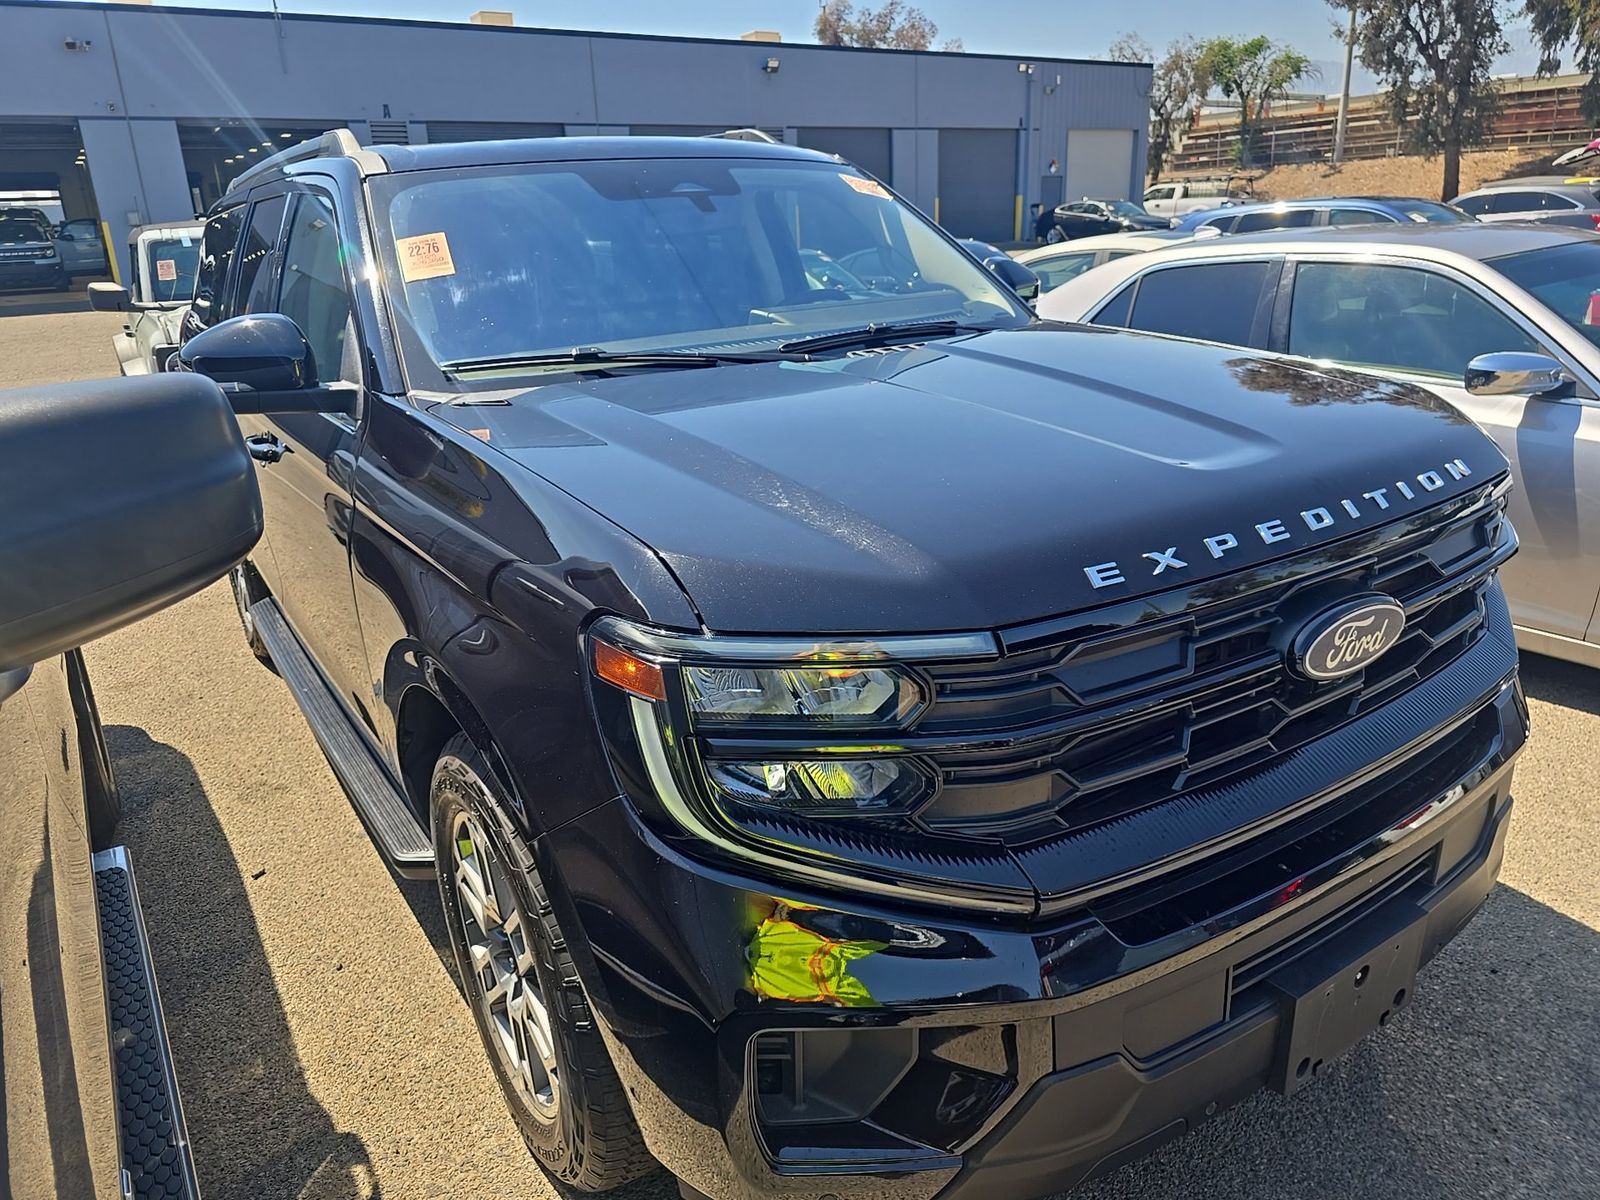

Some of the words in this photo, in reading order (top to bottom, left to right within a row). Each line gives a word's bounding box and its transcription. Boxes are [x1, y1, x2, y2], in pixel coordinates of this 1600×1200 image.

[408, 242, 440, 257] 22:76
[1083, 459, 1472, 589] EXPEDITION
[1326, 614, 1389, 669] Ford
